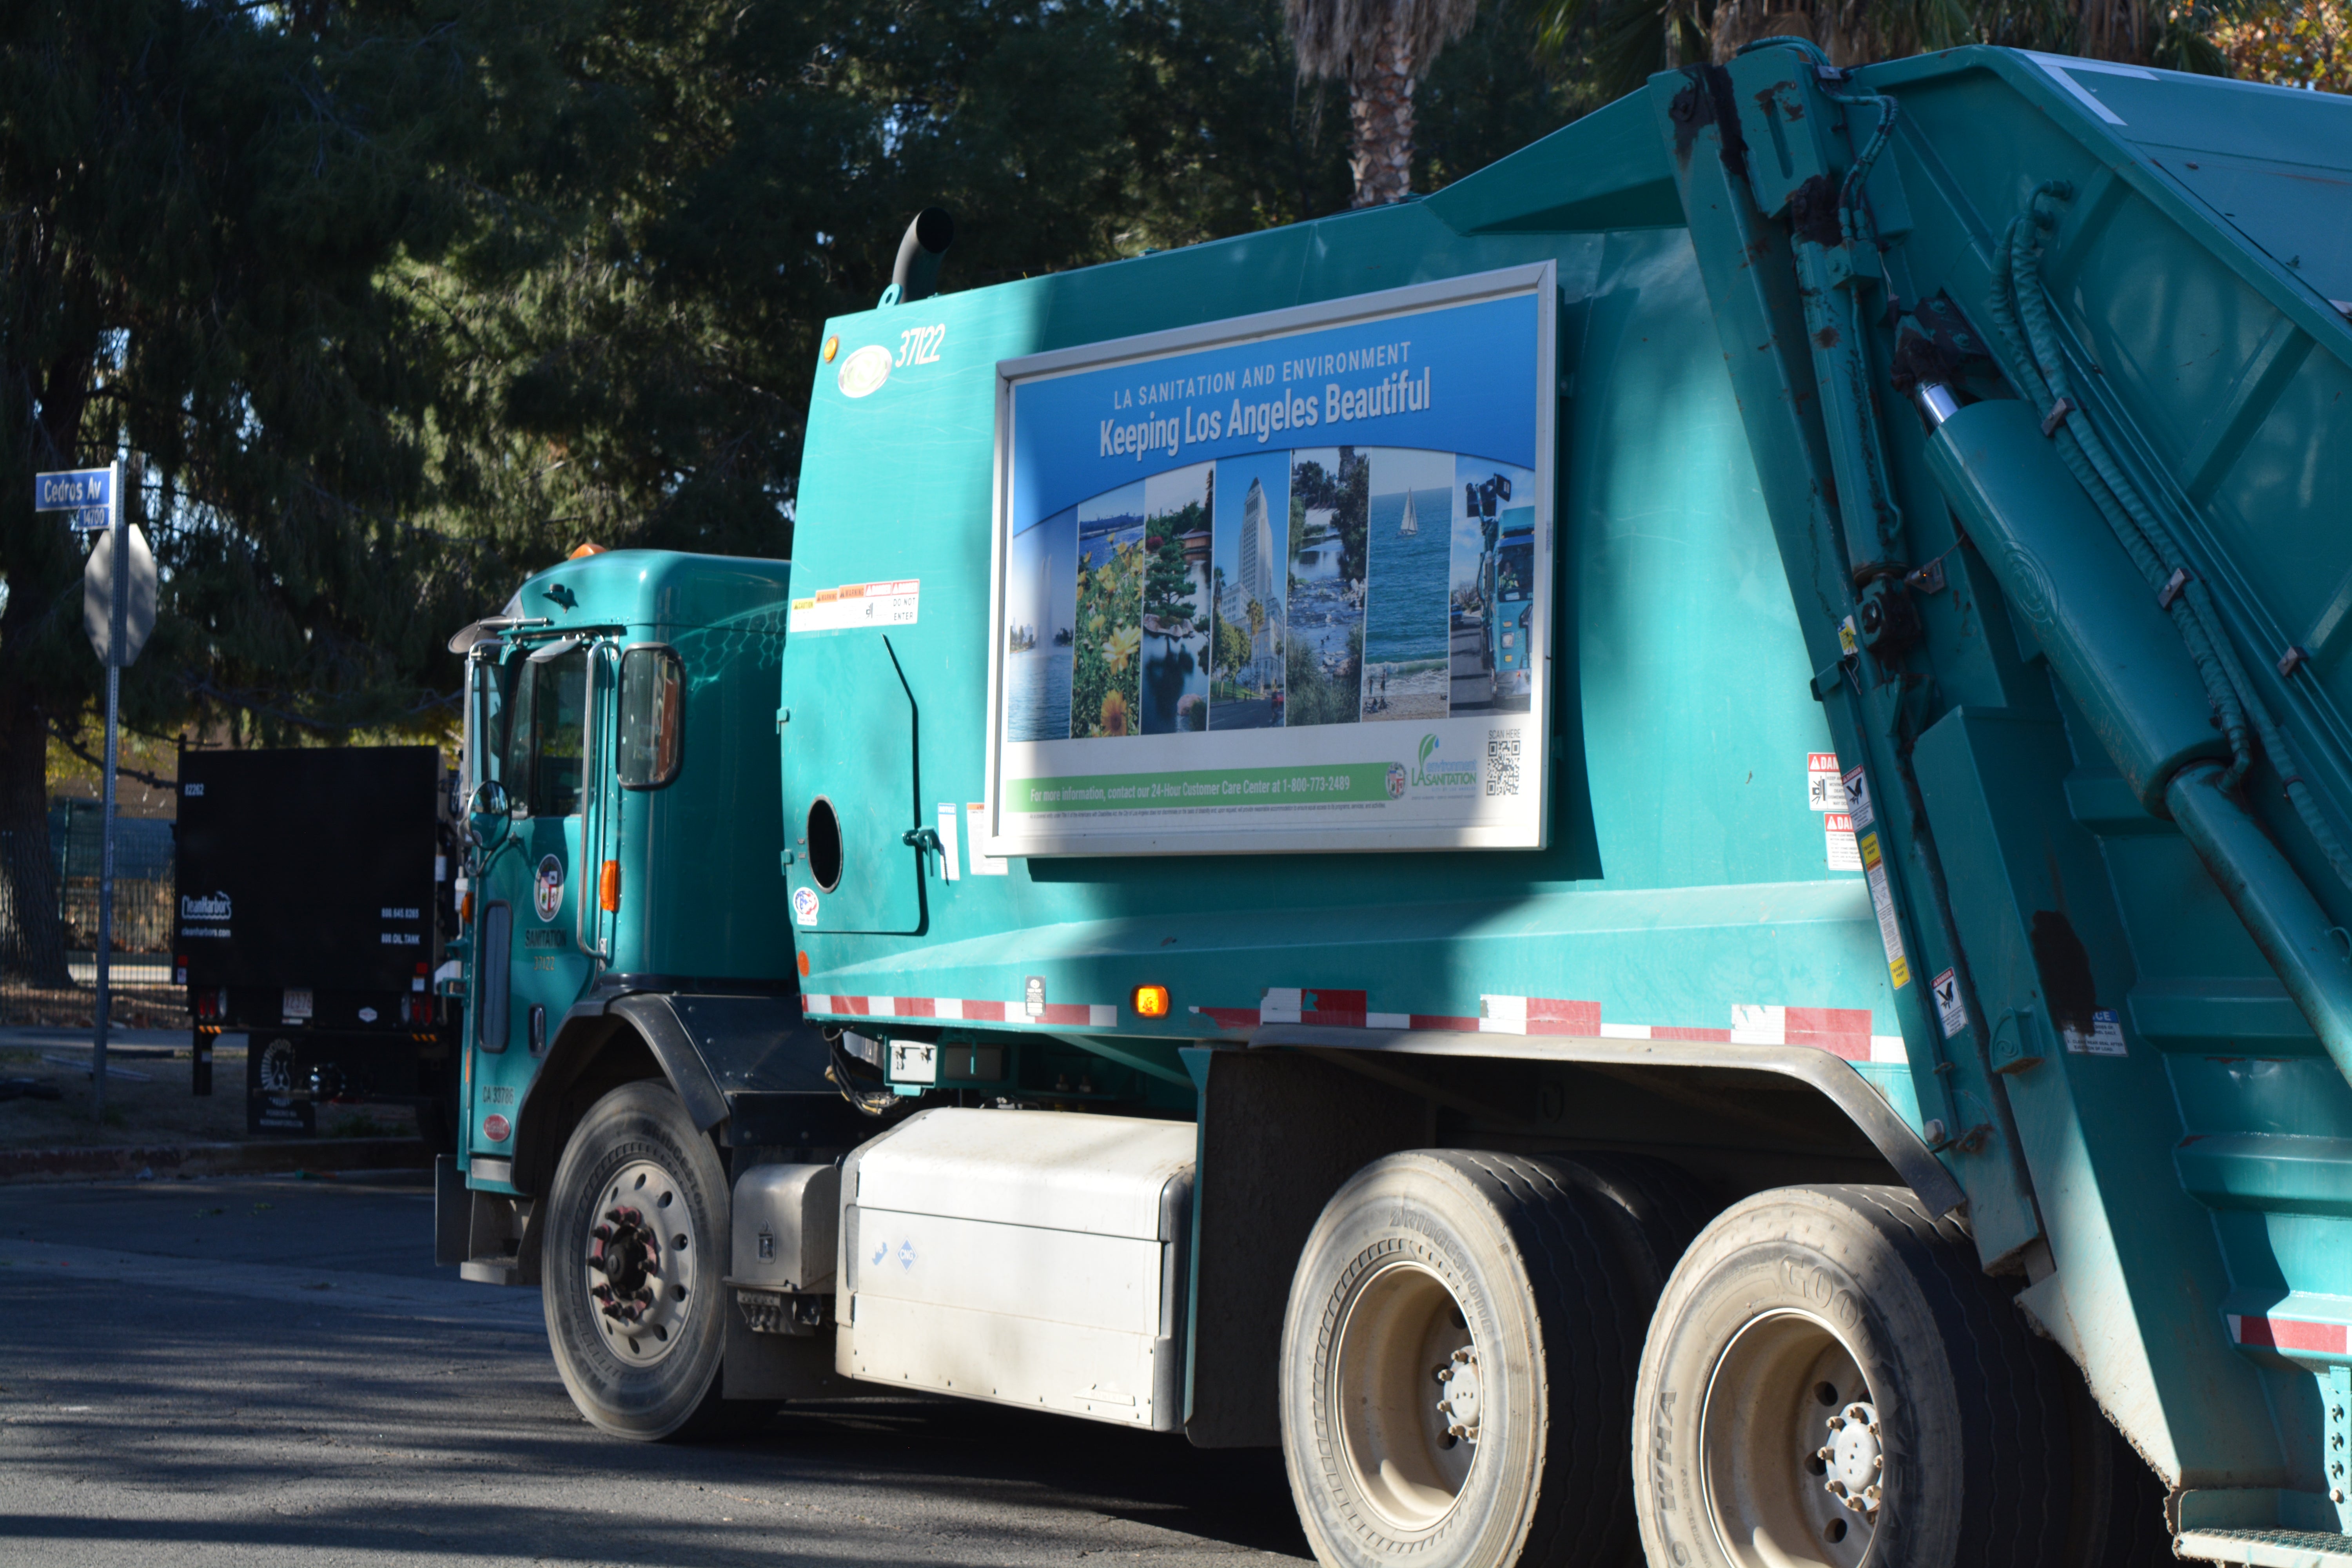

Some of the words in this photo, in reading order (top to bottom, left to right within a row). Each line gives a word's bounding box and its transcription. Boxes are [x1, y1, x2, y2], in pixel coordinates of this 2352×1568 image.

[895, 323, 946, 368] 37122
[1114, 389, 1132, 410] LA
[1139, 371, 1236, 405] SANITATION
[1242, 366, 1275, 389] AND
[1283, 341, 1411, 381] ENVIRONMENT
[1100, 412, 1179, 461] Keeping
[1185, 407, 1222, 444] Los
[1227, 389, 1319, 443] Angeles
[1326, 367, 1430, 424] Beautiful
[44, 479, 83, 503] Cedros
[87, 476, 102, 500] Av
[83, 508, 105, 524] 14700
[821, 593, 838, 601] WARNING
[845, 588, 864, 597] WARNING
[799, 601, 813, 610] CAUTION
[893, 598, 901, 607] DO
[904, 597, 916, 606] NOT
[894, 612, 913, 621] ENTER
[1488, 730, 1504, 739] SCAN
[1506, 729, 1521, 738] HERE
[1820, 756, 1840, 770] DAN
[1031, 788, 1042, 802] For
[1044, 790, 1060, 801] more
[1062, 786, 1106, 802] information,
[1108, 786, 1135, 799] contact
[1138, 787, 1150, 798] our
[1152, 783, 1181, 797] 24-Hour
[1183, 782, 1220, 796] Customer
[1222, 780, 1241, 795] Care
[1243, 780, 1270, 793] Center
[1272, 780, 1280, 793] at
[1283, 775, 1350, 792] 1-800-773-2489
[1864, 840, 1876, 851] TAILGATE
[526, 929, 567, 947] SANITATION
[534, 956, 555, 971] 37122
[1892, 962, 1906, 973] TAILGATE
[1896, 971, 1904, 979] PROP
[483, 1086, 491, 1103] CA
[493, 1086, 514, 1104] 33786
[900, 1249, 914, 1260] CNG
[1389, 1206, 1494, 1334] BRIDGESTONE
